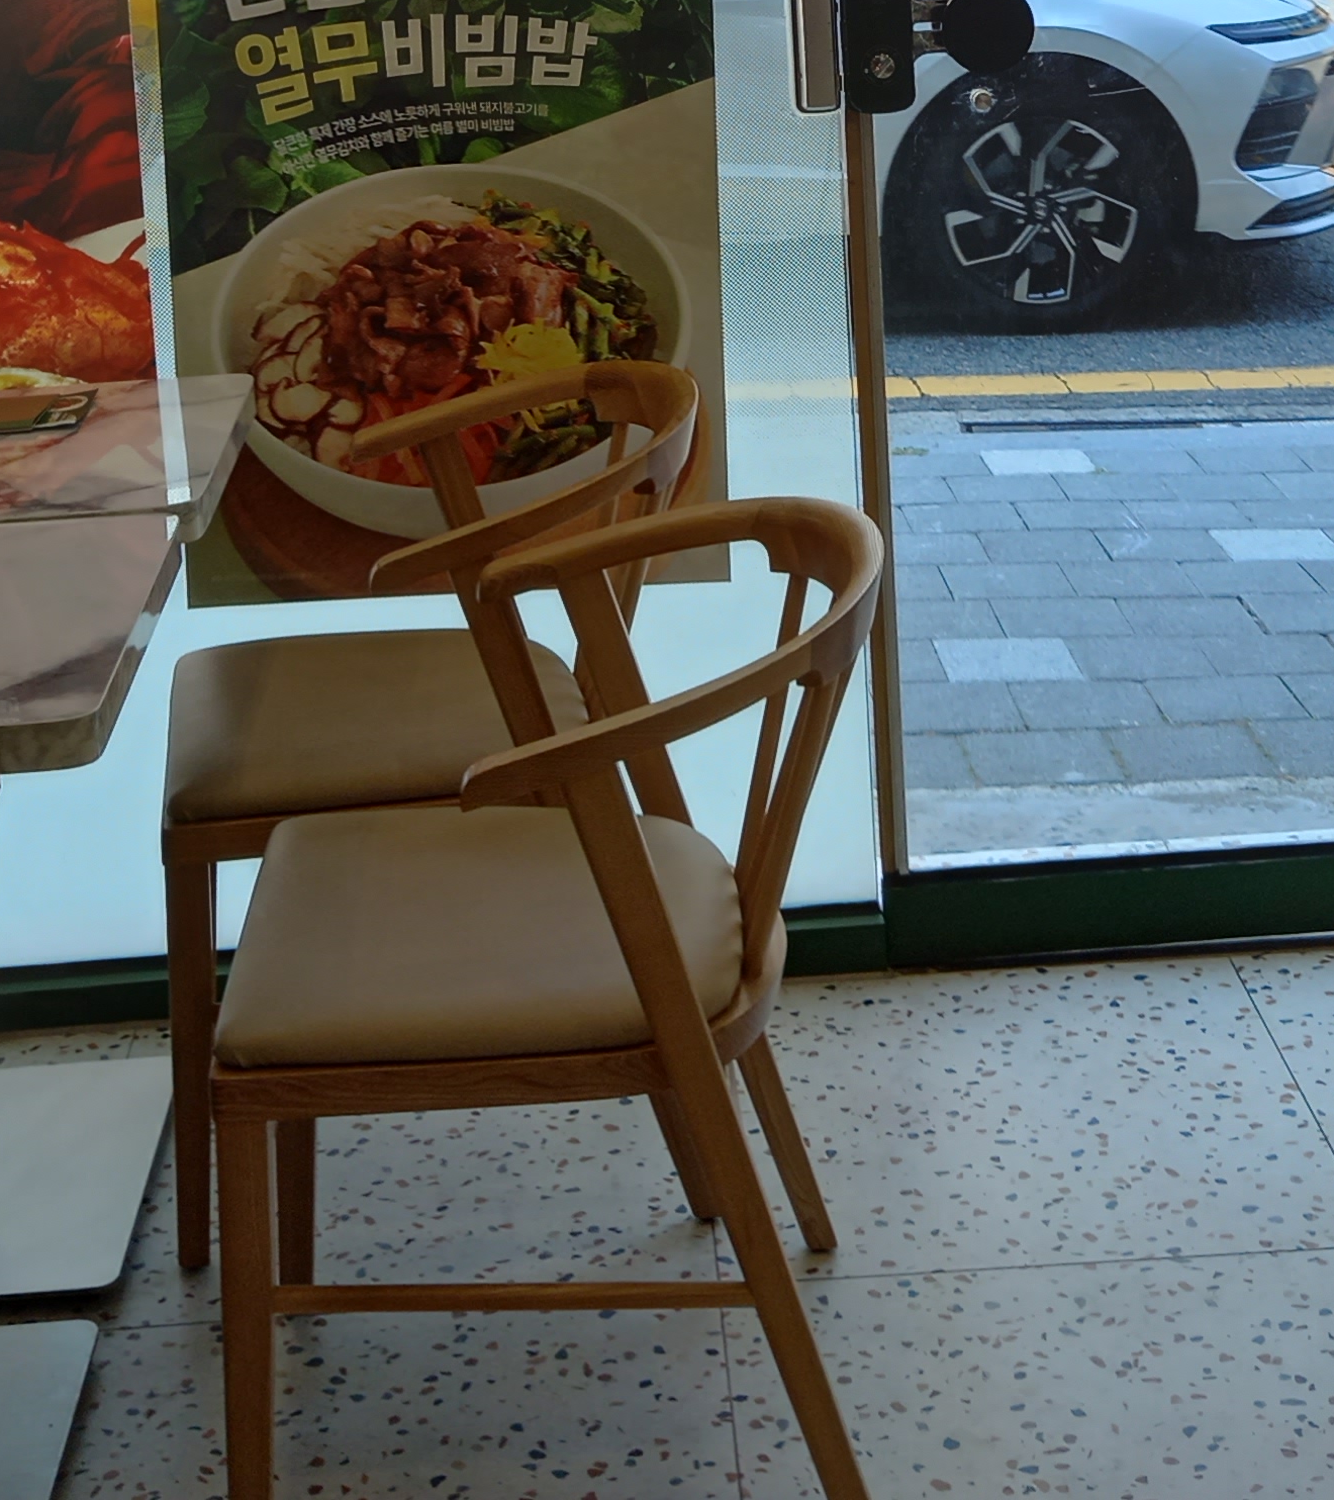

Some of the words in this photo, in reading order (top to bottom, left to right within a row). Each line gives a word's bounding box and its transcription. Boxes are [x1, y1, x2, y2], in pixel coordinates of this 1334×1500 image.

[234, 13, 598, 125] 열무비빔밥
[333, 118, 358, 137] 간장
[357, 109, 394, 130] 소스에
[394, 103, 441, 124] 노릇하게
[442, 102, 478, 118] 구워낸
[479, 101, 549, 117] 돼지불고기를
[480, 119, 515, 132] 비빔밥
